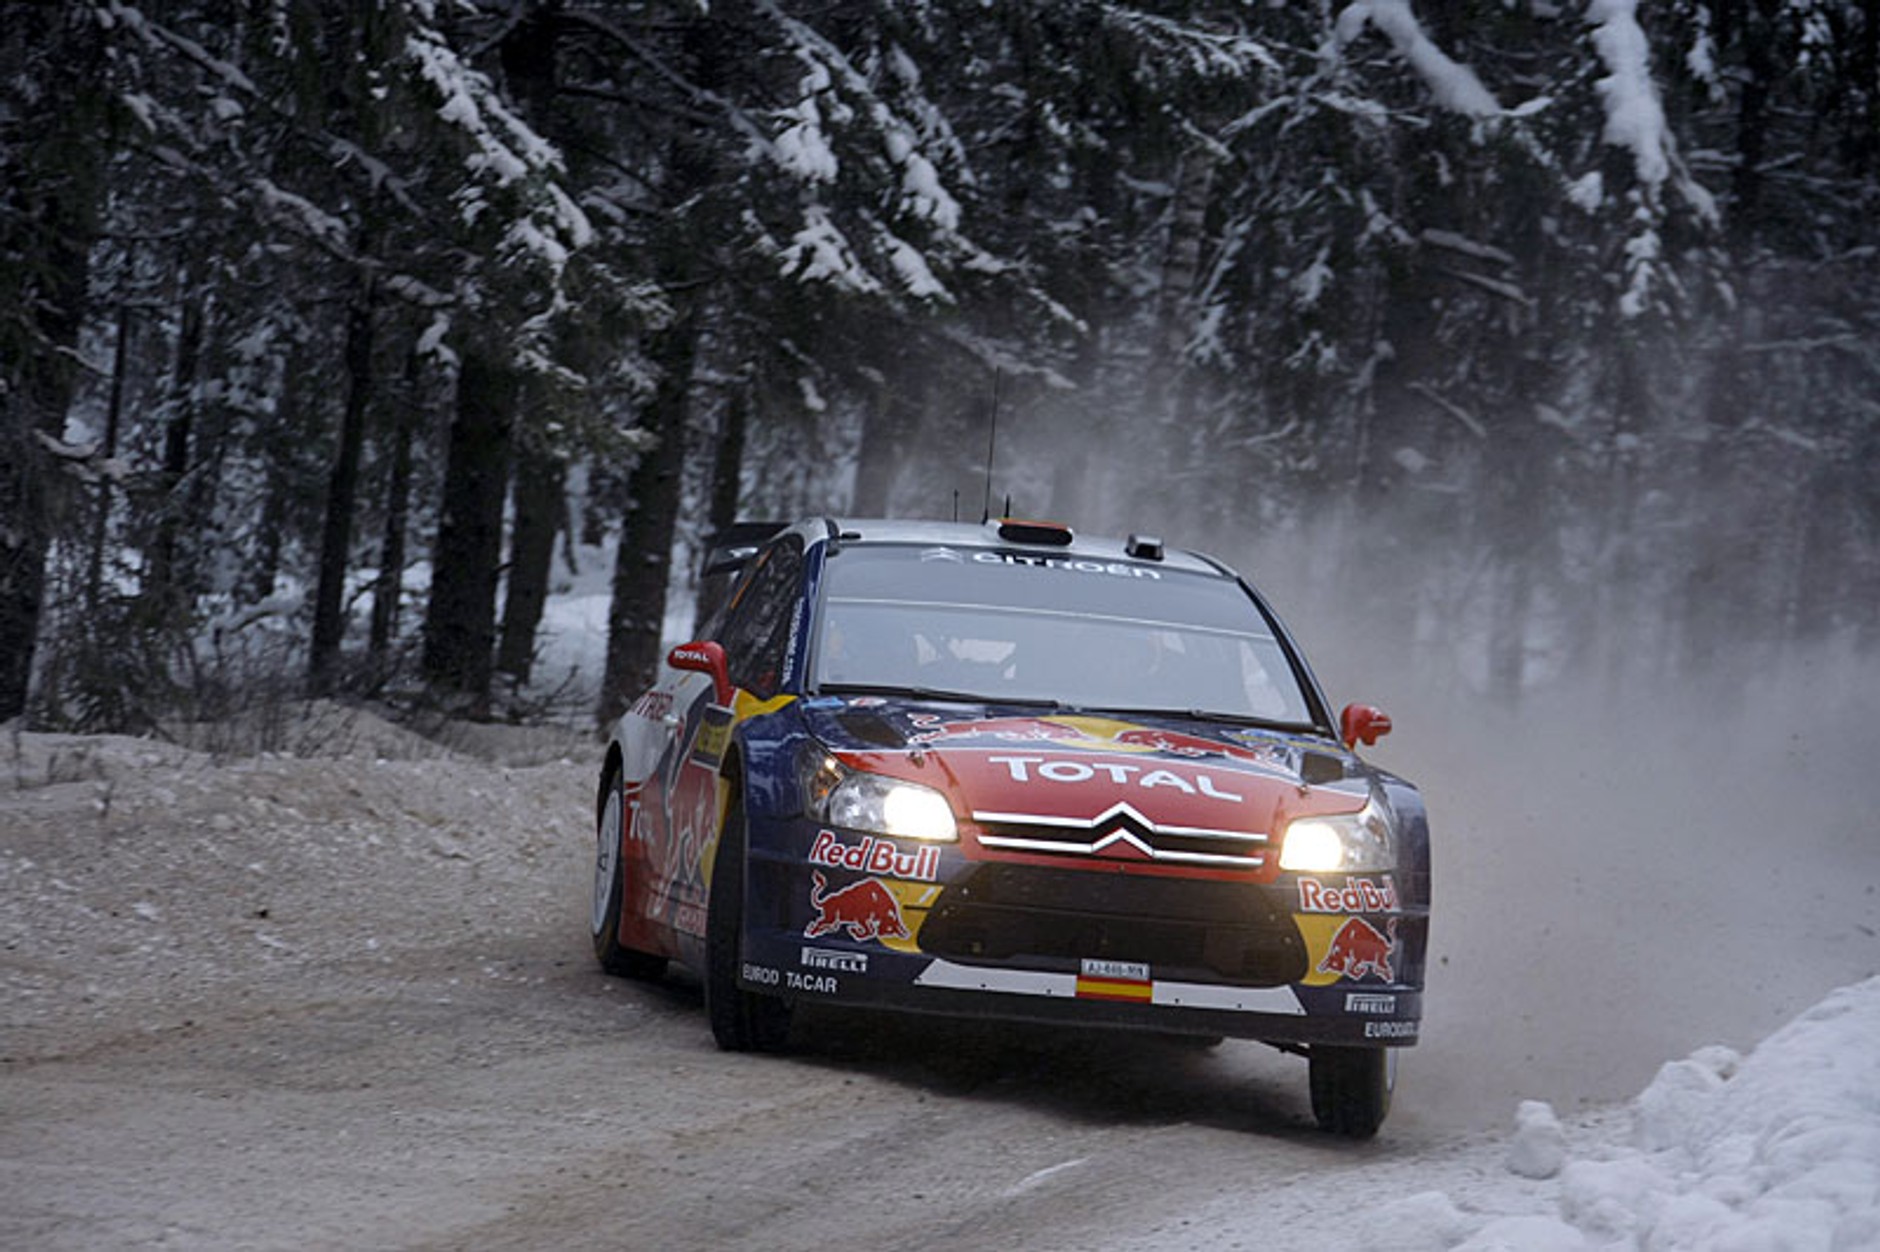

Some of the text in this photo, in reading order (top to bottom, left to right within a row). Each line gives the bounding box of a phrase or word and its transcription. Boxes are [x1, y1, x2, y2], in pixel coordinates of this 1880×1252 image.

[674, 649, 709, 663] TOTAL
[988, 756, 1242, 802] TOTAL
[809, 829, 941, 882] Red Bull
[1297, 875, 1364, 912] Red
[801, 946, 868, 972] PIRELLI
[785, 971, 838, 993] TACAR
[1344, 993, 1396, 1014] PIRELLI
